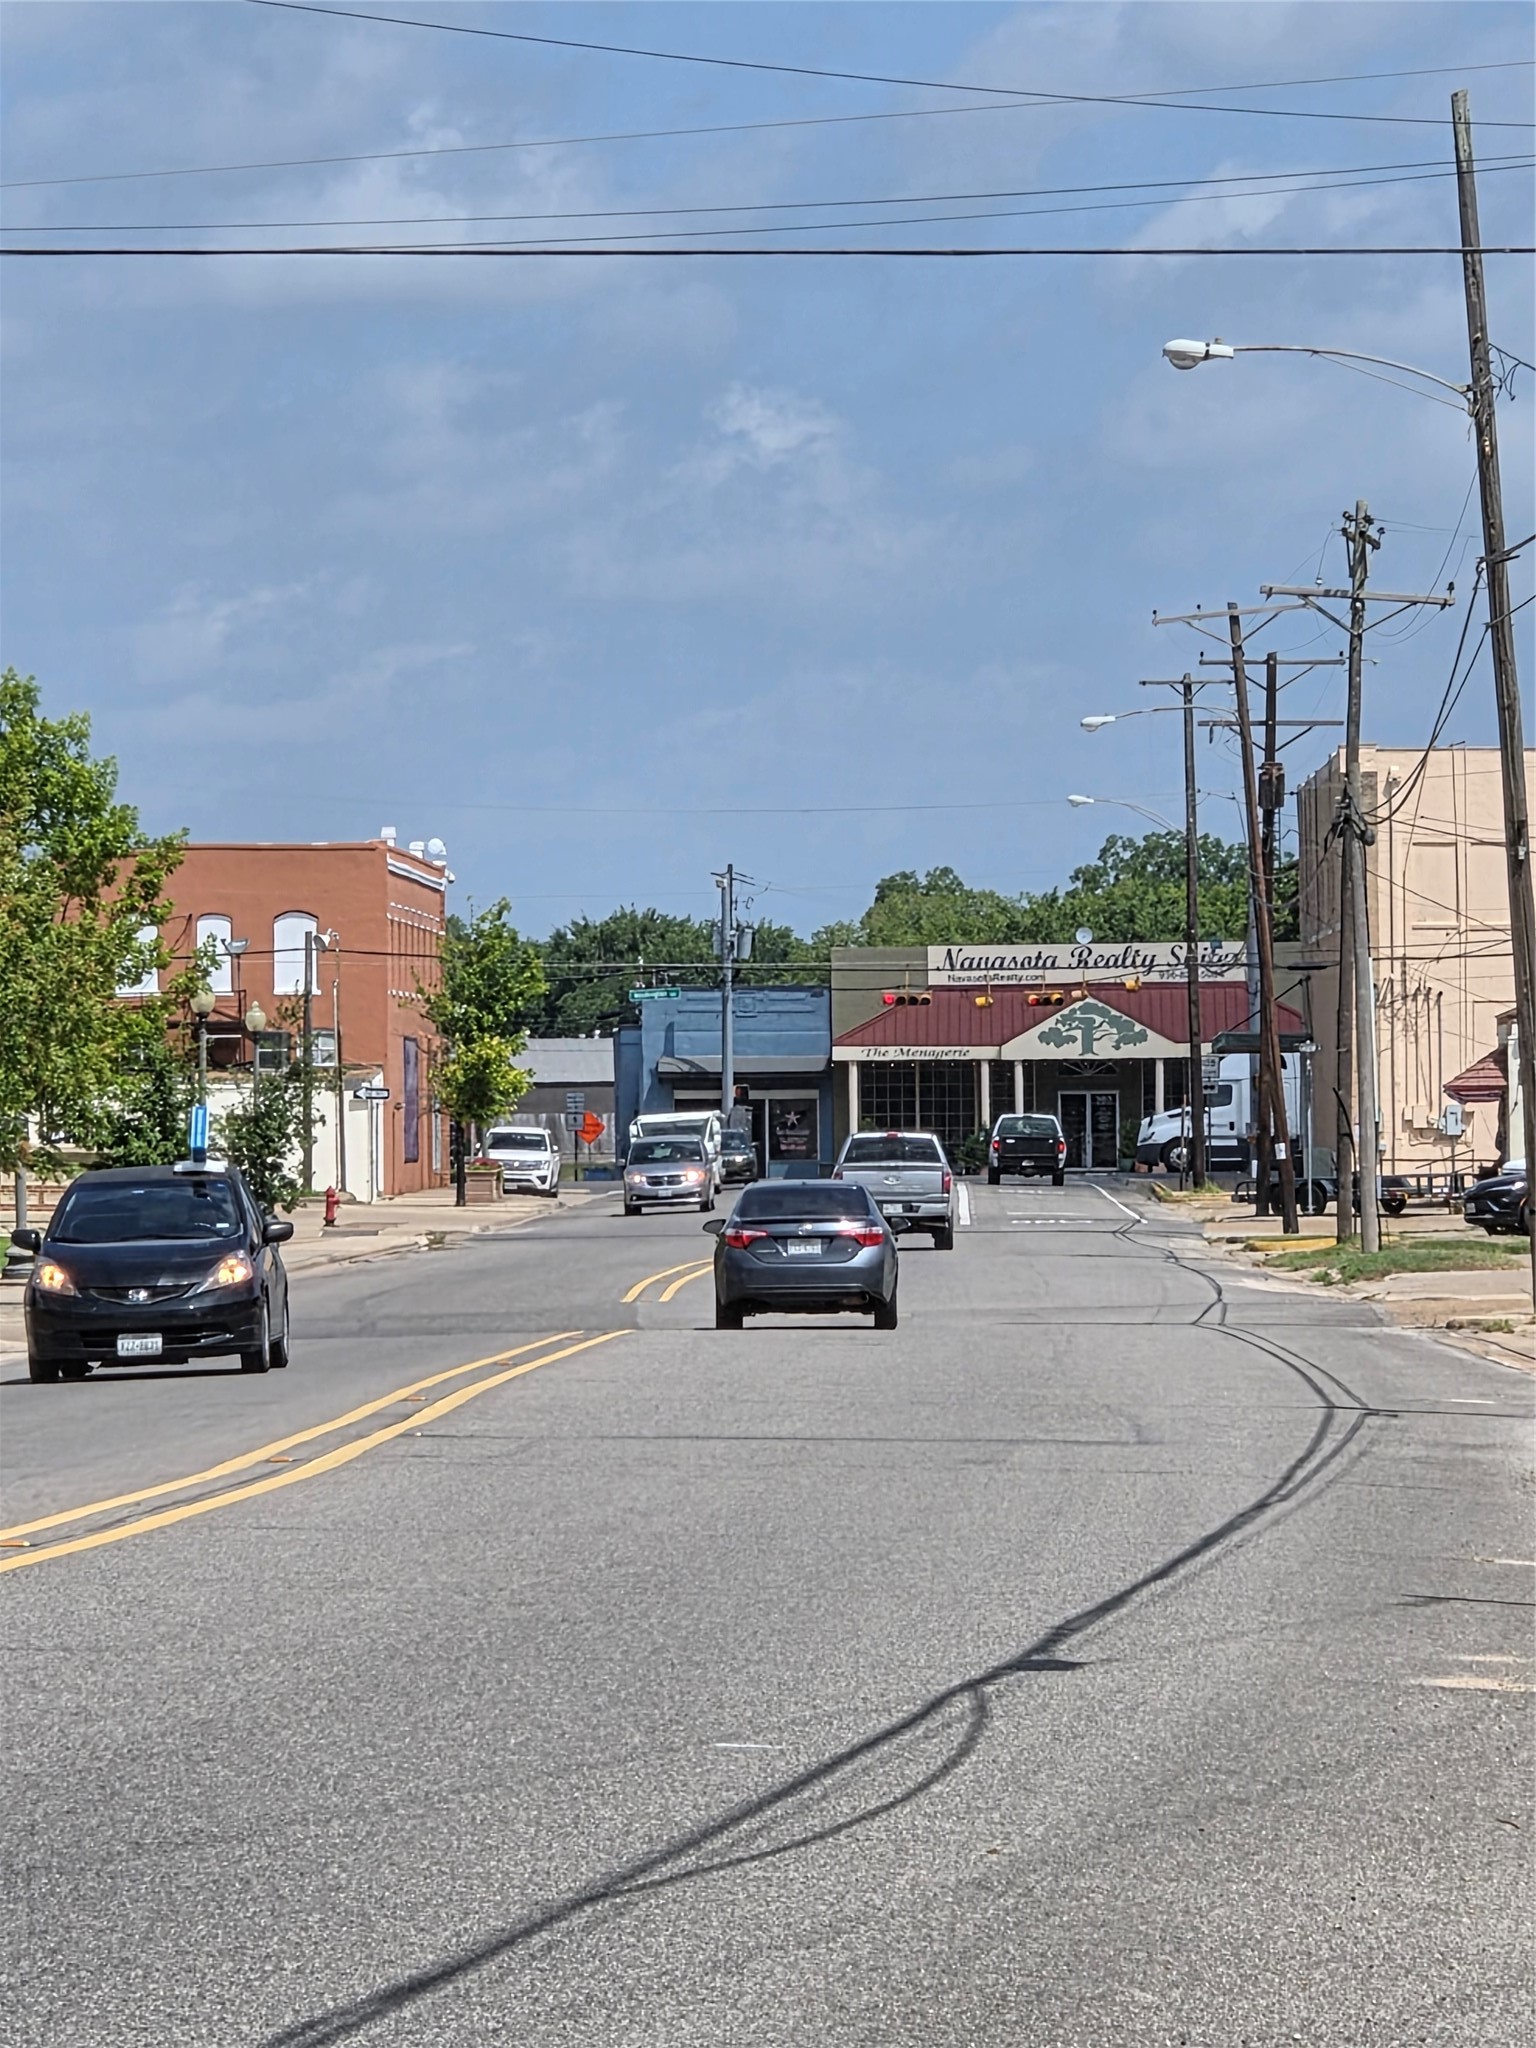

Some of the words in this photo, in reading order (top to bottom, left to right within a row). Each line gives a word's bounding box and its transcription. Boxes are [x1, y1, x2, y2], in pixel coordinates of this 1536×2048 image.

[937, 947, 1058, 971] Navasota
[1068, 944, 1156, 976] Realty
[861, 1047, 889, 1058] The
[893, 1047, 970, 1059] Menagerie
